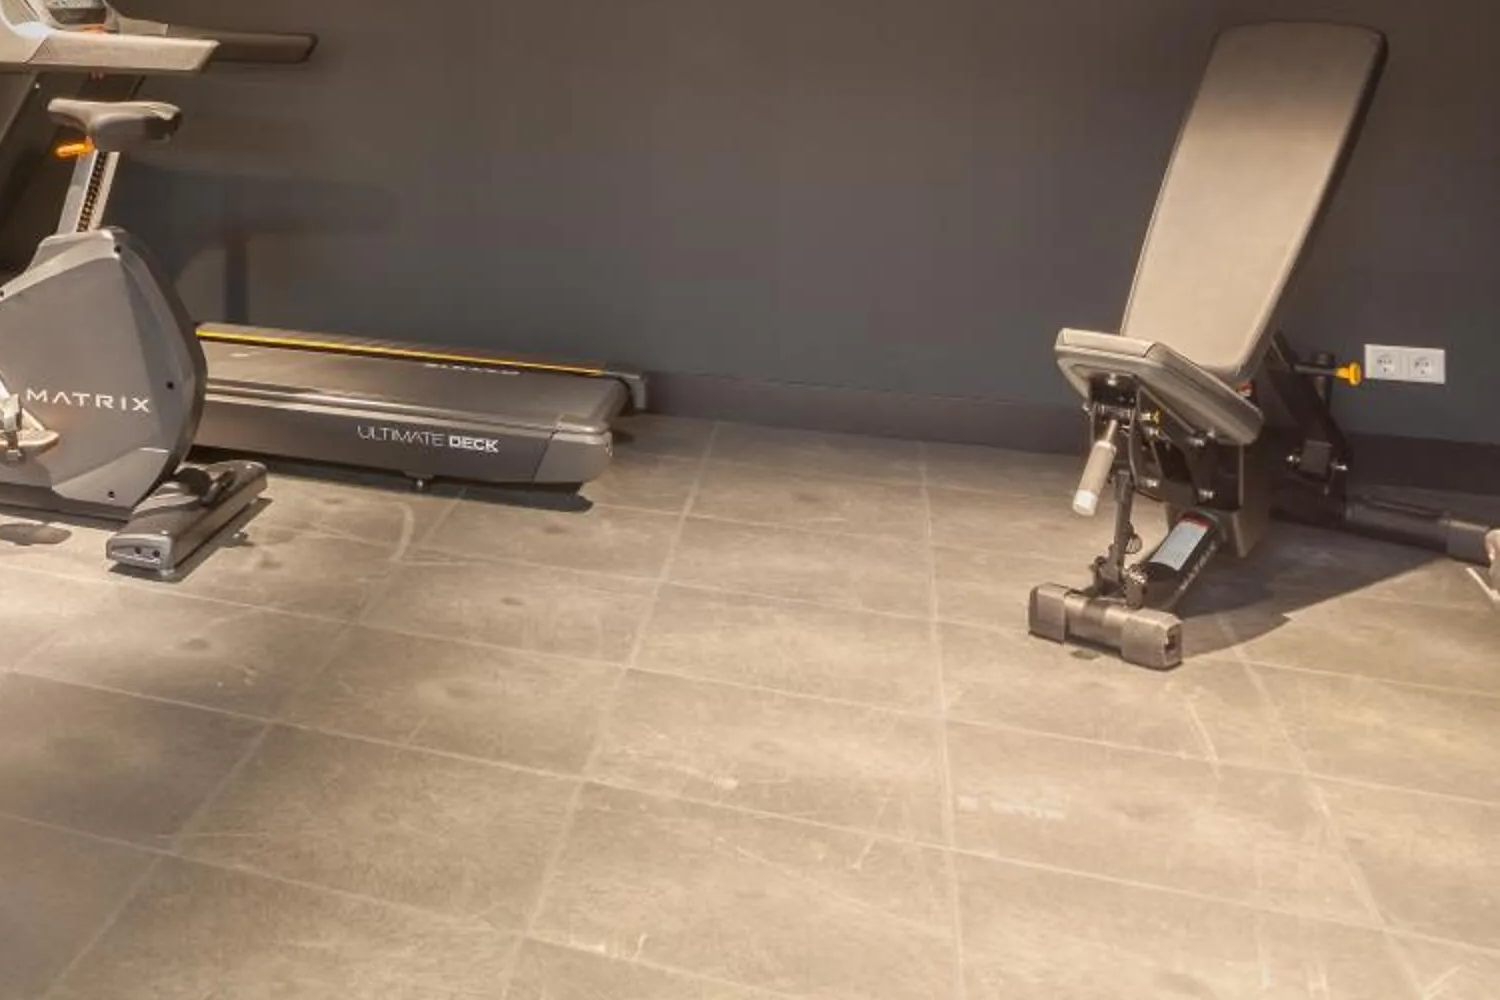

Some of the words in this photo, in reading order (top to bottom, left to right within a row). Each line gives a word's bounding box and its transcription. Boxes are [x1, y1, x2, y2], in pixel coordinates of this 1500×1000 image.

[26, 387, 150, 413] MATRIX
[357, 425, 446, 447] ULTIMATE
[449, 435, 500, 453] DECK
